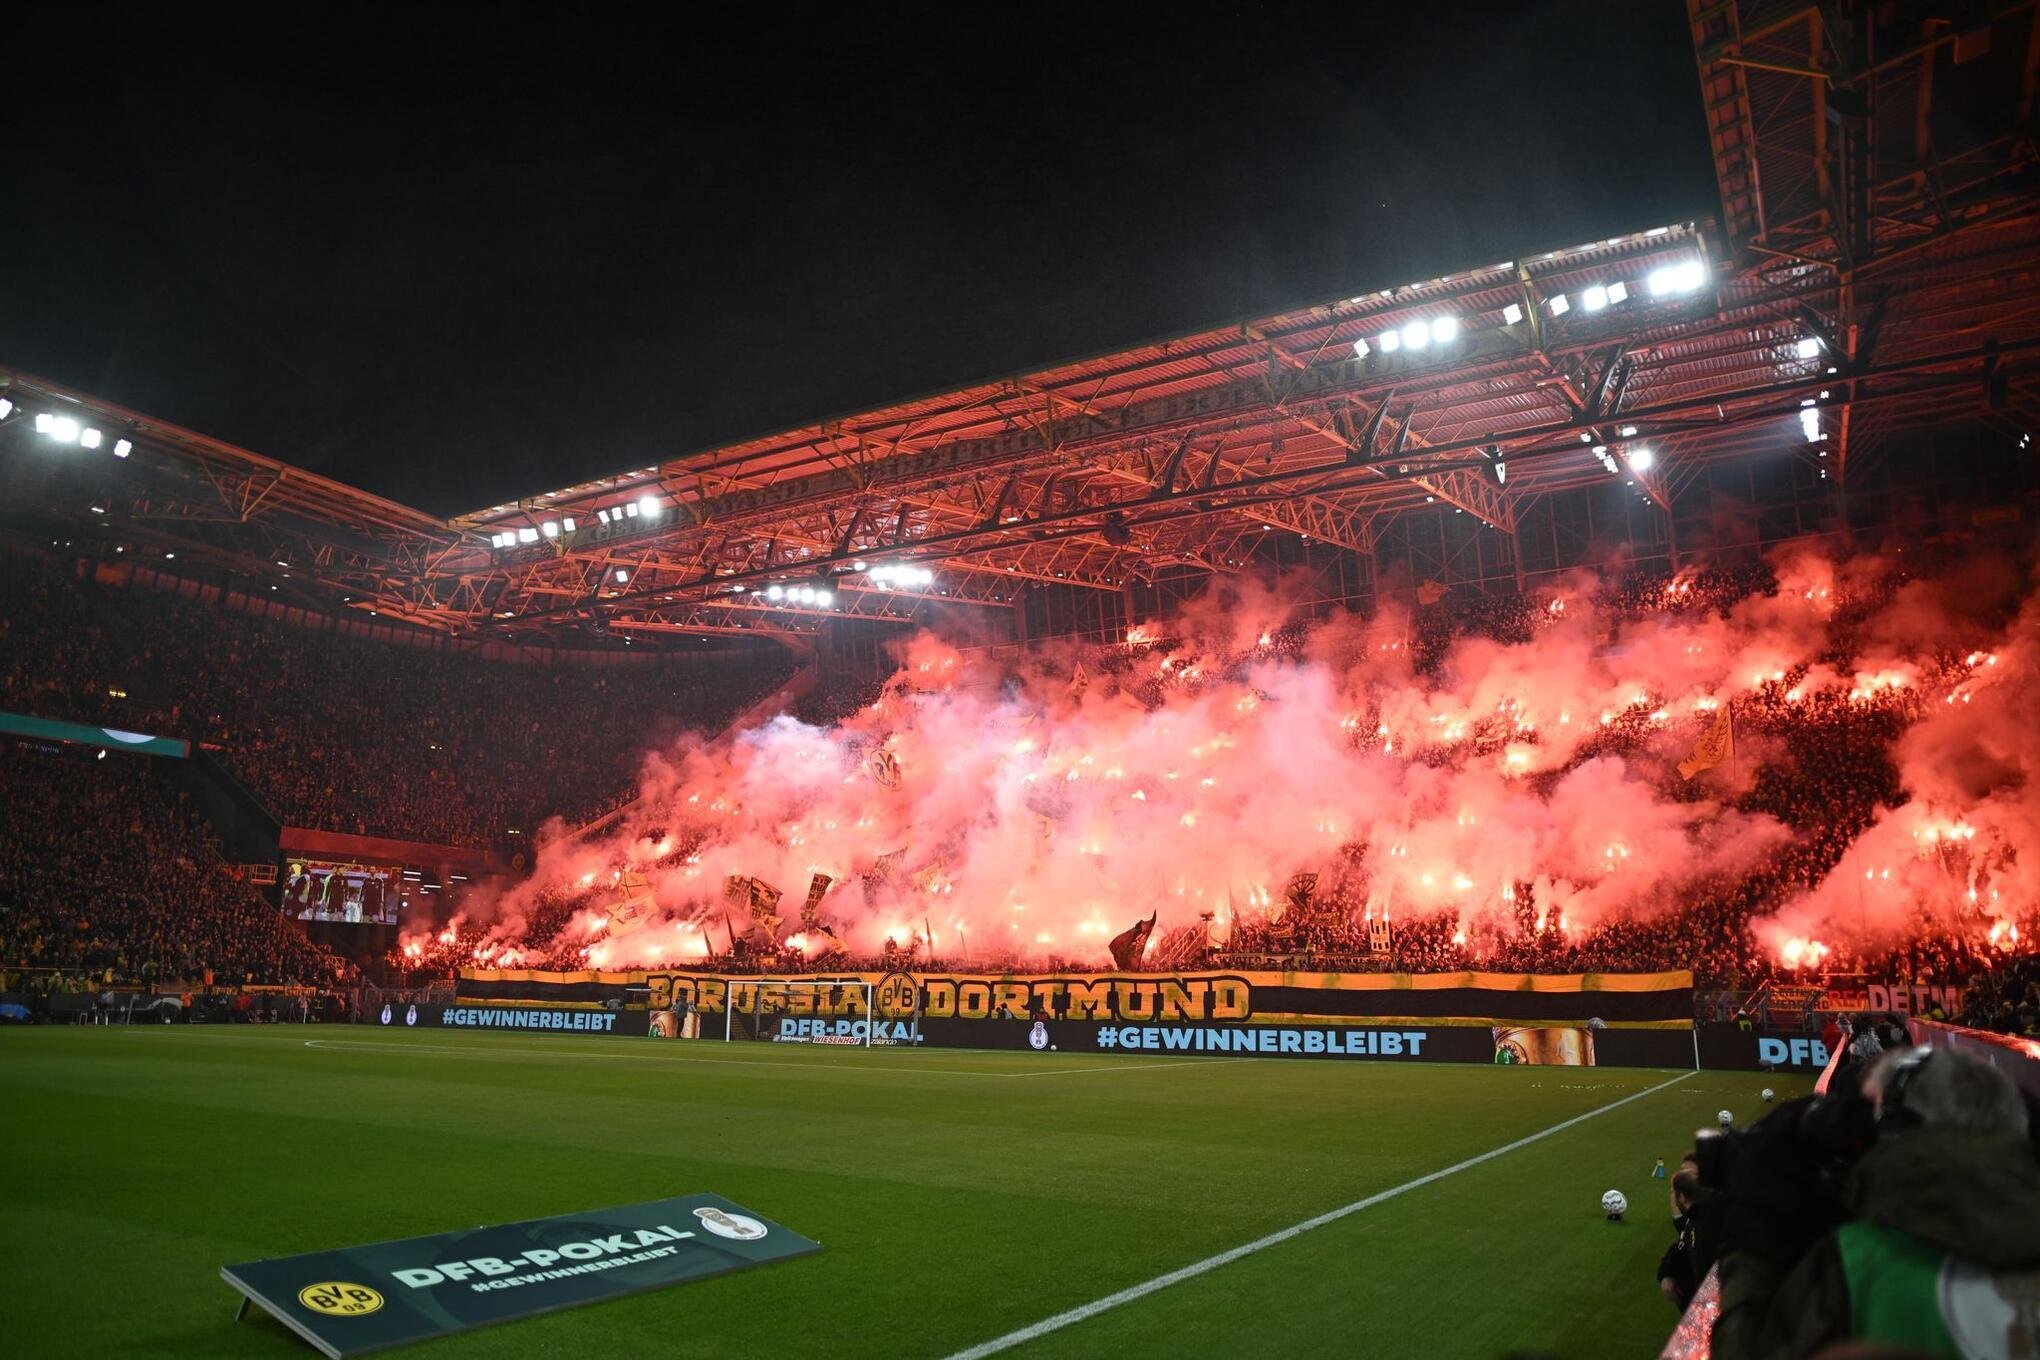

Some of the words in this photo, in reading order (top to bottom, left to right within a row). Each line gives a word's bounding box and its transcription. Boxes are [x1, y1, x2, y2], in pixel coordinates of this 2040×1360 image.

[646, 974, 868, 1014] BORUSSIA
[924, 974, 1250, 1021] DORTMUND
[882, 978, 913, 1008] BVB
[442, 1008, 617, 1031] #GEWINNERBLEIBT
[780, 1018, 924, 1042] DFB-POKAL
[814, 1036, 860, 1044] WIESENHOF
[870, 1038, 898, 1046] zalando
[1097, 1026, 1426, 1056] #GEWINNERBLEIBT
[391, 1225, 696, 1289] DFB-POKAL
[471, 1245, 679, 1292] #GEWINNERBLEIBT
[310, 1285, 374, 1309] BVB
[342, 1302, 367, 1313] 09
